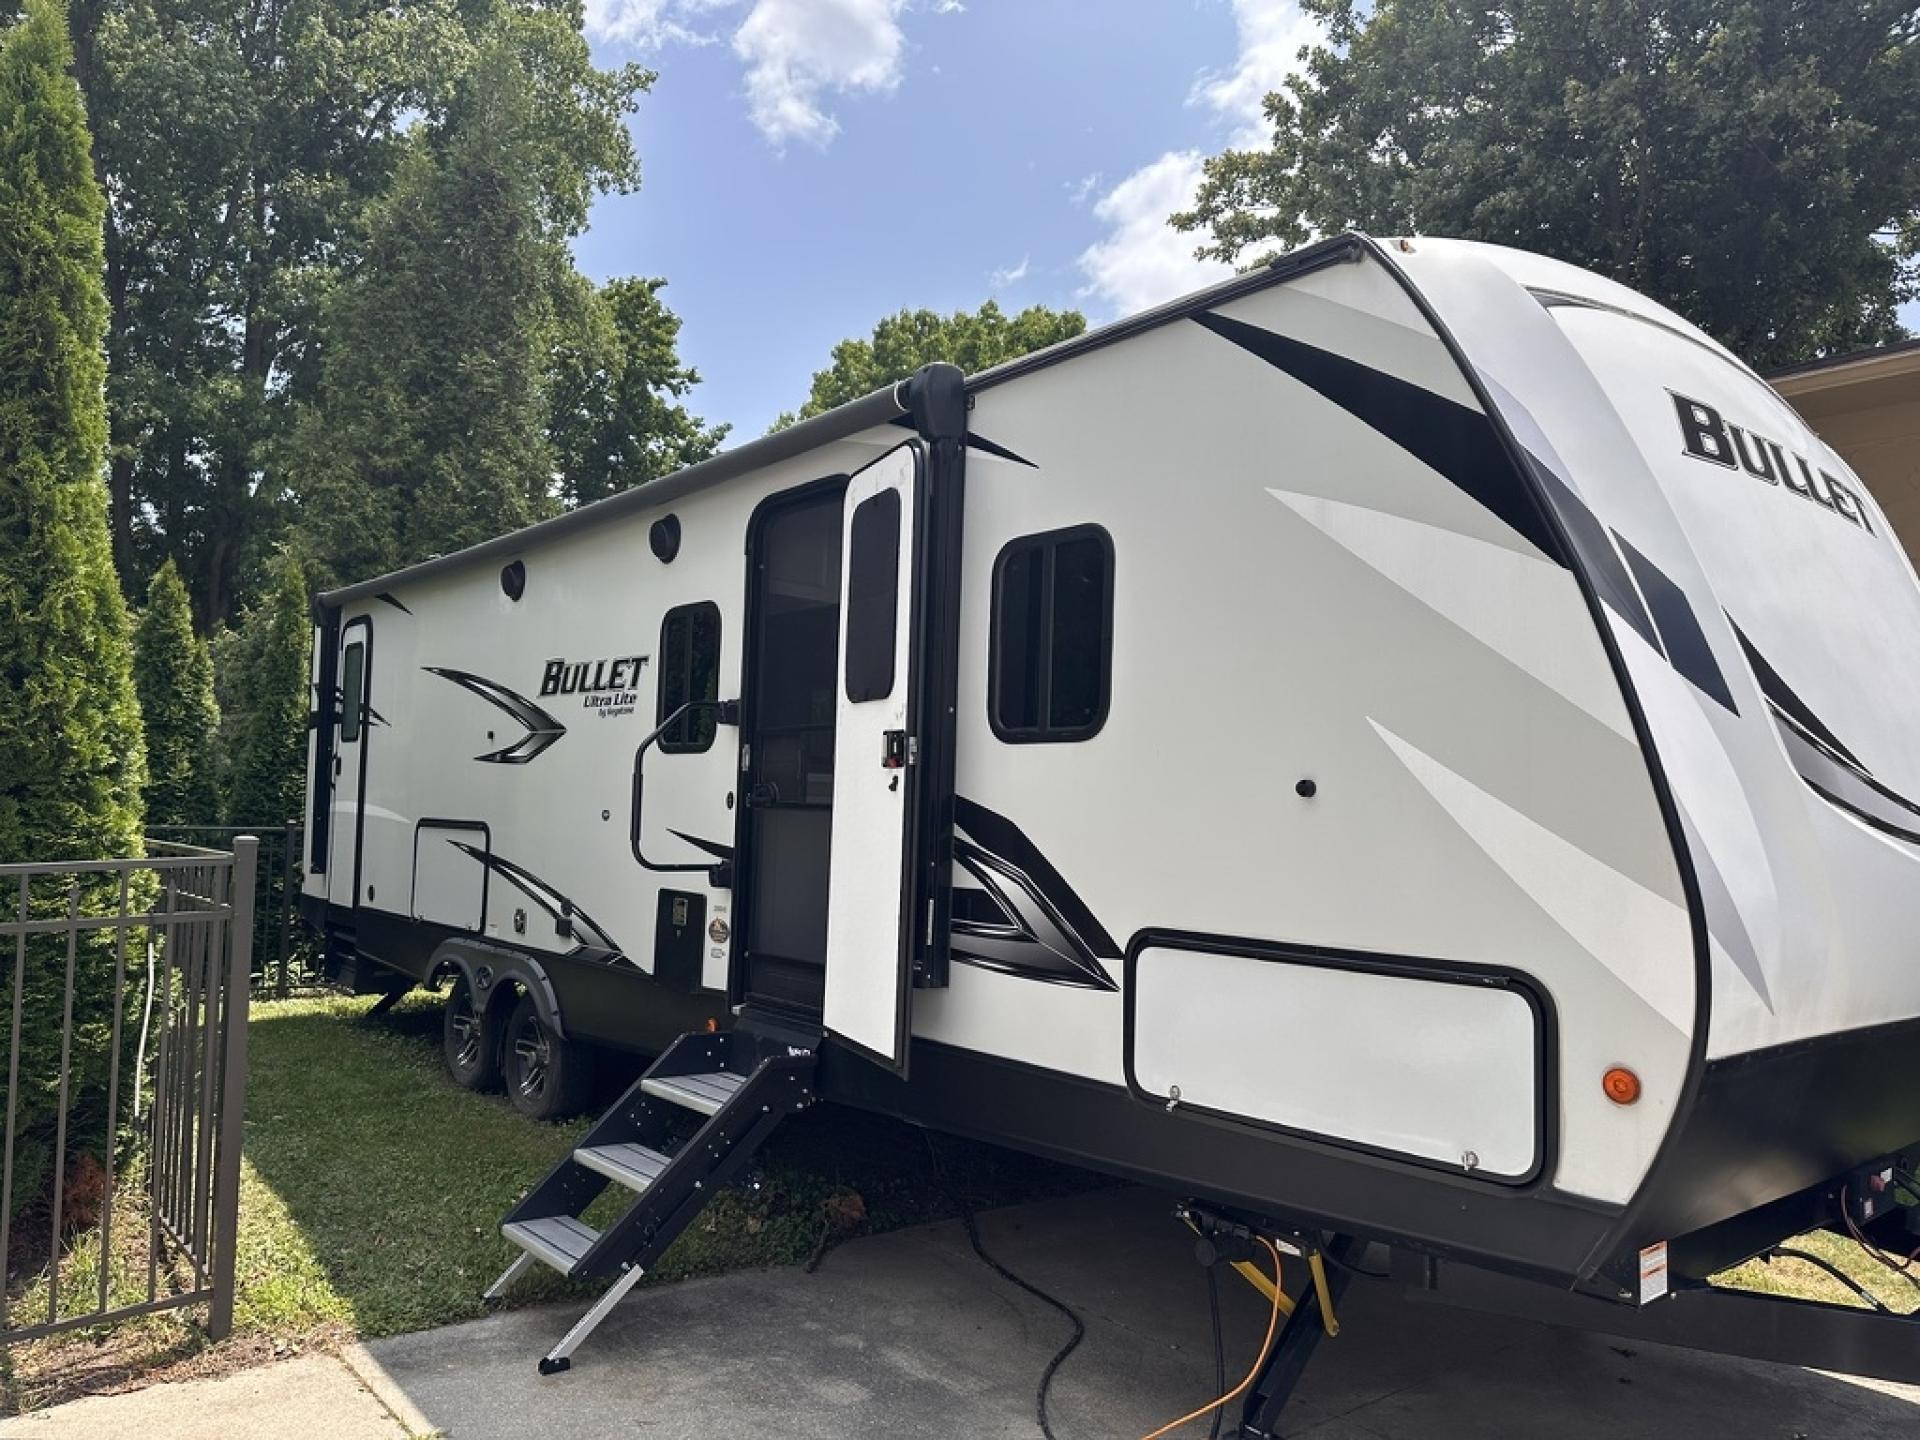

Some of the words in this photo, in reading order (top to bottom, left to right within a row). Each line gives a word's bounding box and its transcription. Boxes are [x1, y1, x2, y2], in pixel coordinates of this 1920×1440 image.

[1663, 386, 1877, 538] BULLET
[538, 655, 650, 698] BULLET
[583, 695, 612, 708] Ultra
[613, 692, 638, 705] Lite
